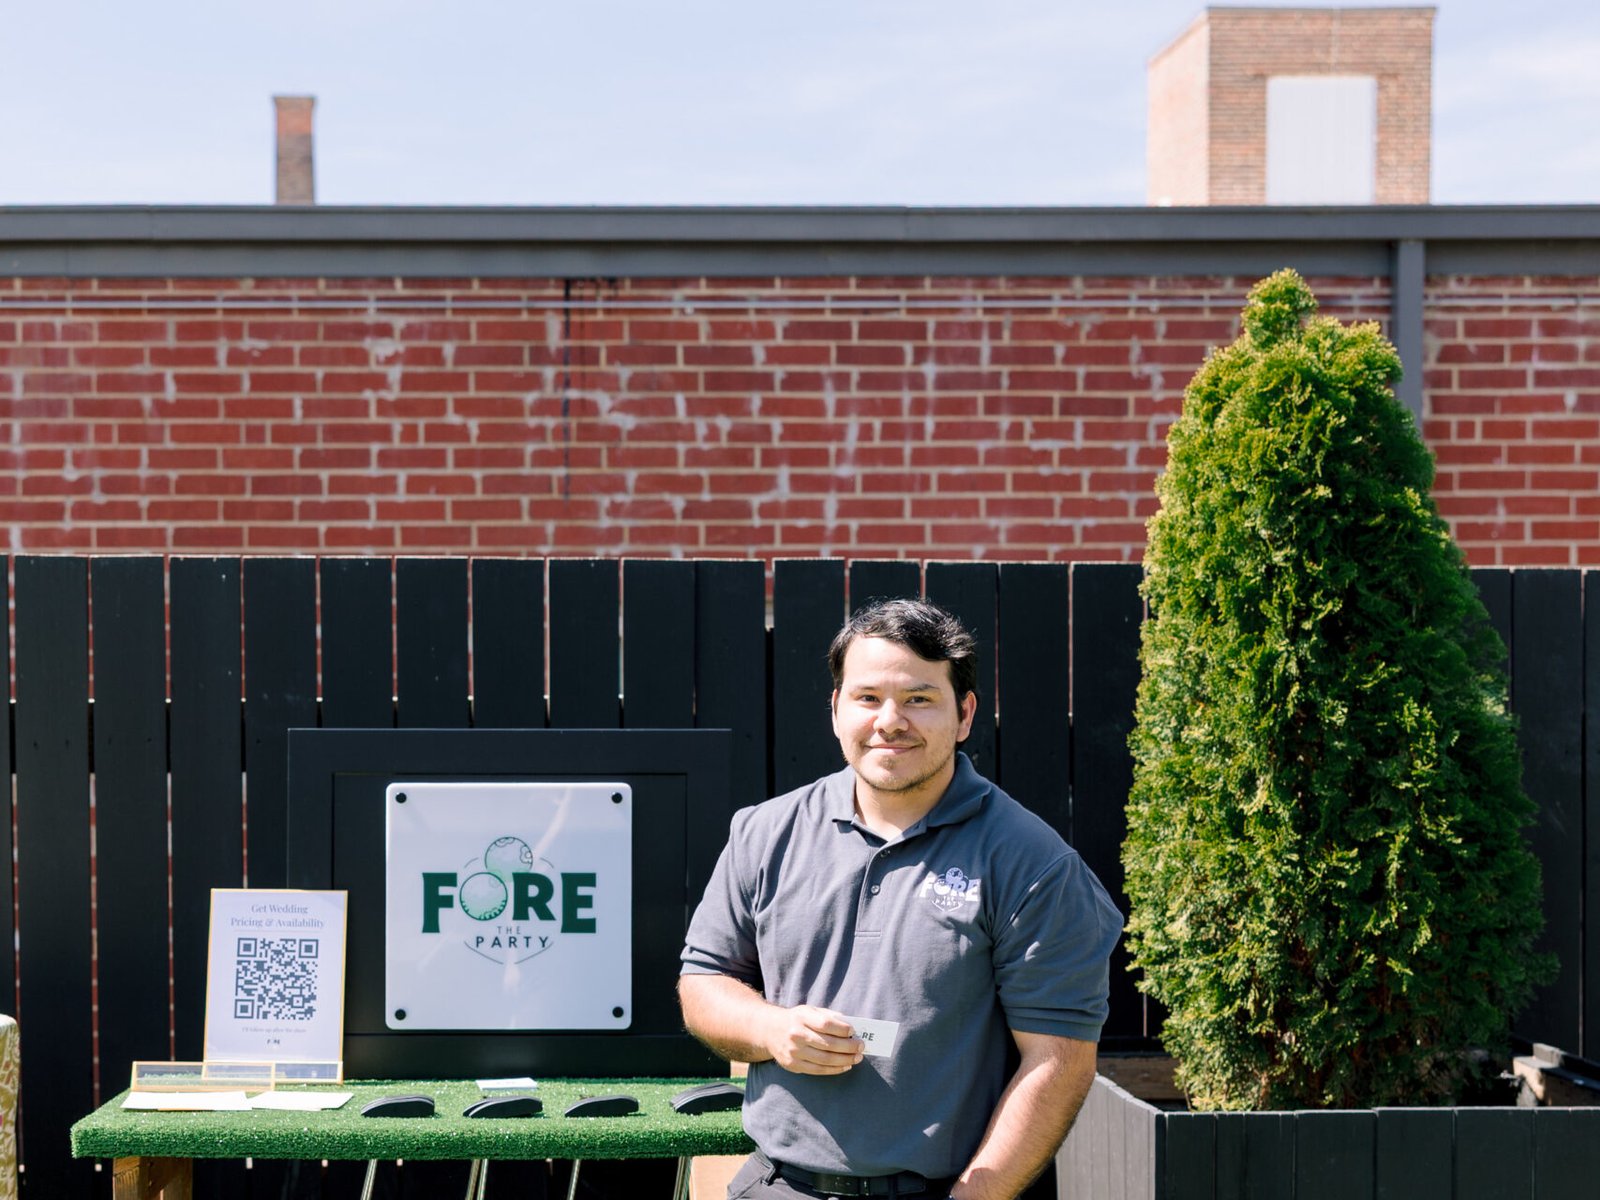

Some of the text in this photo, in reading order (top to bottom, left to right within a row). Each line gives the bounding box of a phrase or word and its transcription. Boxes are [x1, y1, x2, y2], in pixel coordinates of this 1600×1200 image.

[422, 872, 597, 933] FORE
[250, 904, 309, 914] Get Wedding
[230, 917, 324, 929] Pricing & Availability
[497, 925, 521, 935] THE
[475, 936, 549, 948] PARTY
[861, 1031, 875, 1041] RE
